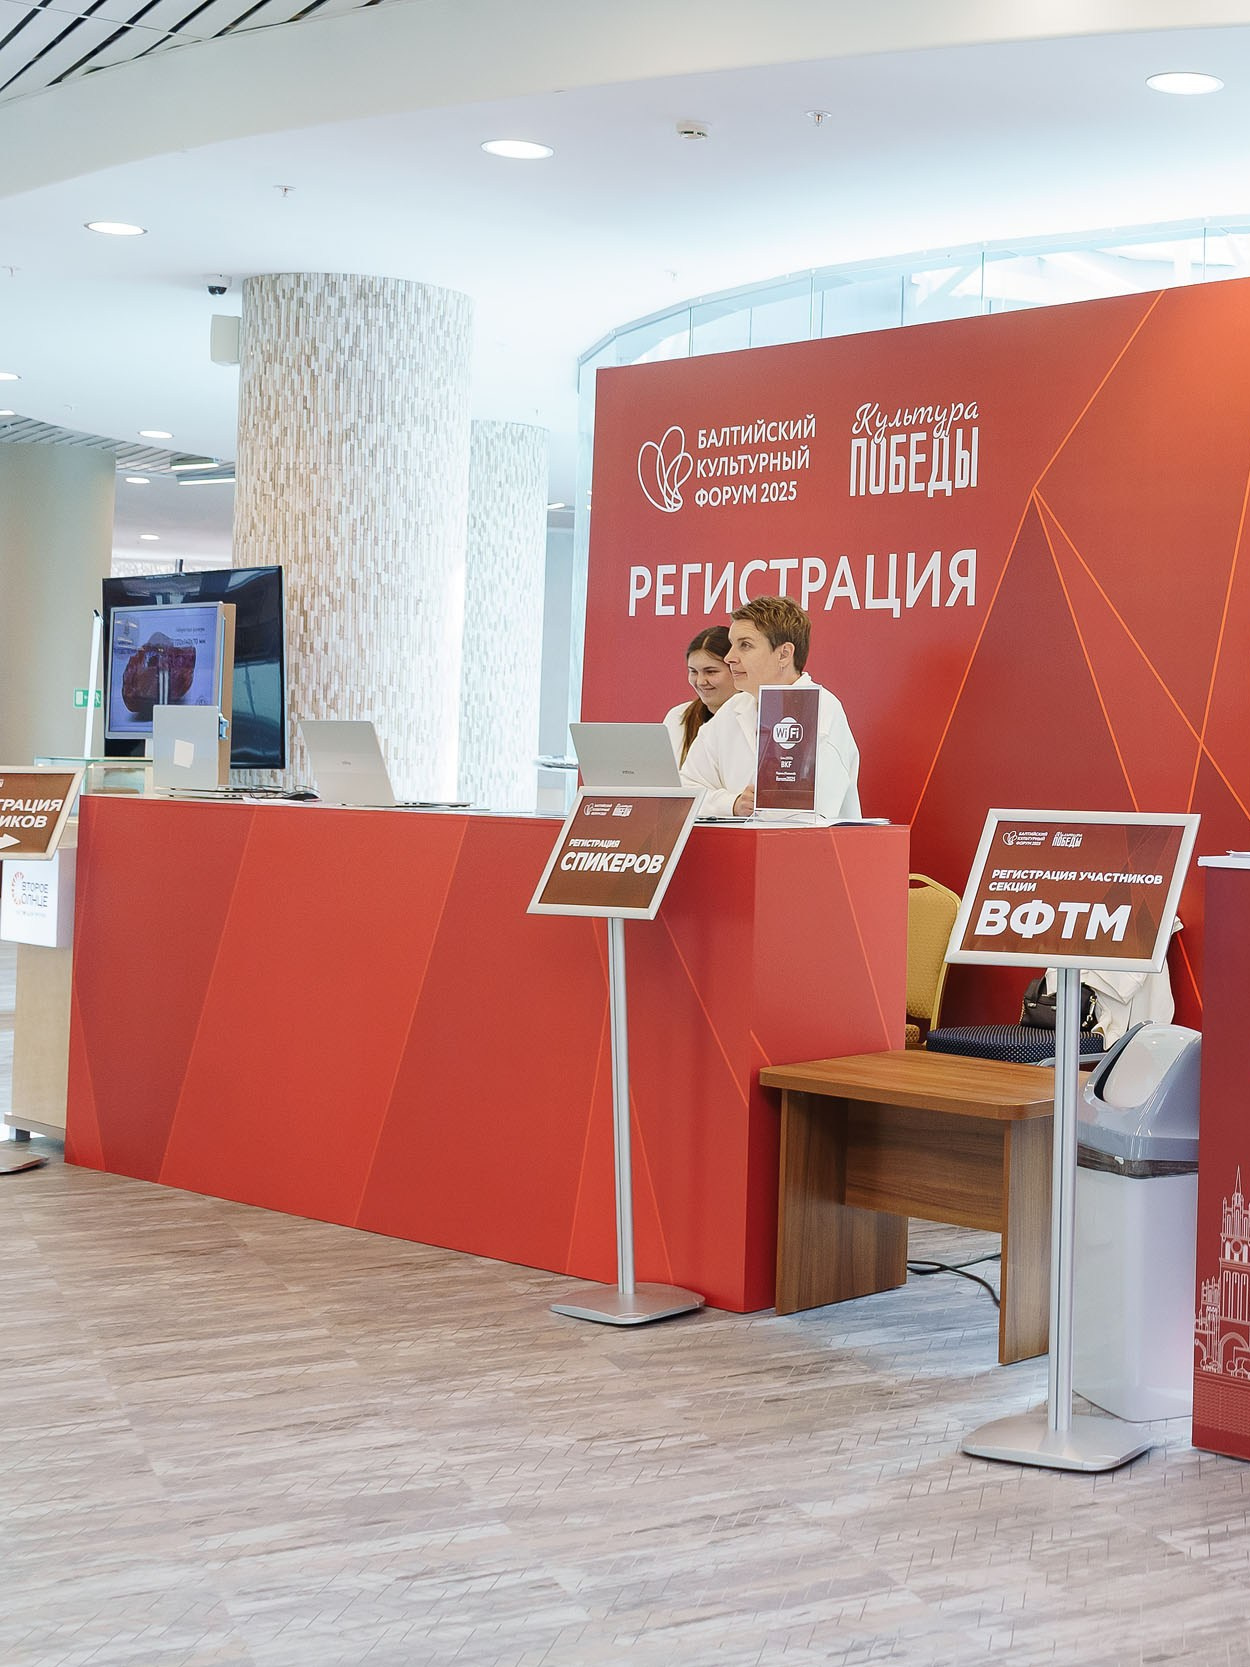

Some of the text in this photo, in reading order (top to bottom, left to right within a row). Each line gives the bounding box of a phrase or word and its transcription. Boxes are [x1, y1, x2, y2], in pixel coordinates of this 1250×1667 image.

[697, 414, 817, 449] БАЛТИЙСКИЙ
[852, 401, 979, 444] Культура
[696, 445, 810, 478] КУЛЬТУРНЫЙ
[849, 426, 980, 498] ПОБЕДЫ
[694, 481, 797, 508] ФОРУМ 2025
[628, 549, 978, 618] РЕГИСТРАЦИЯ
[569, 838, 621, 849] РЕГИСТРАЦИЯ
[560, 852, 665, 874] СПИКЕРОВ
[992, 869, 1163, 885] РЕГИСТРАЦИЯ УЧАСТНИКОВ
[988, 882, 1036, 892] СЕКЦИИ
[974, 900, 1132, 942] ВФТМ
